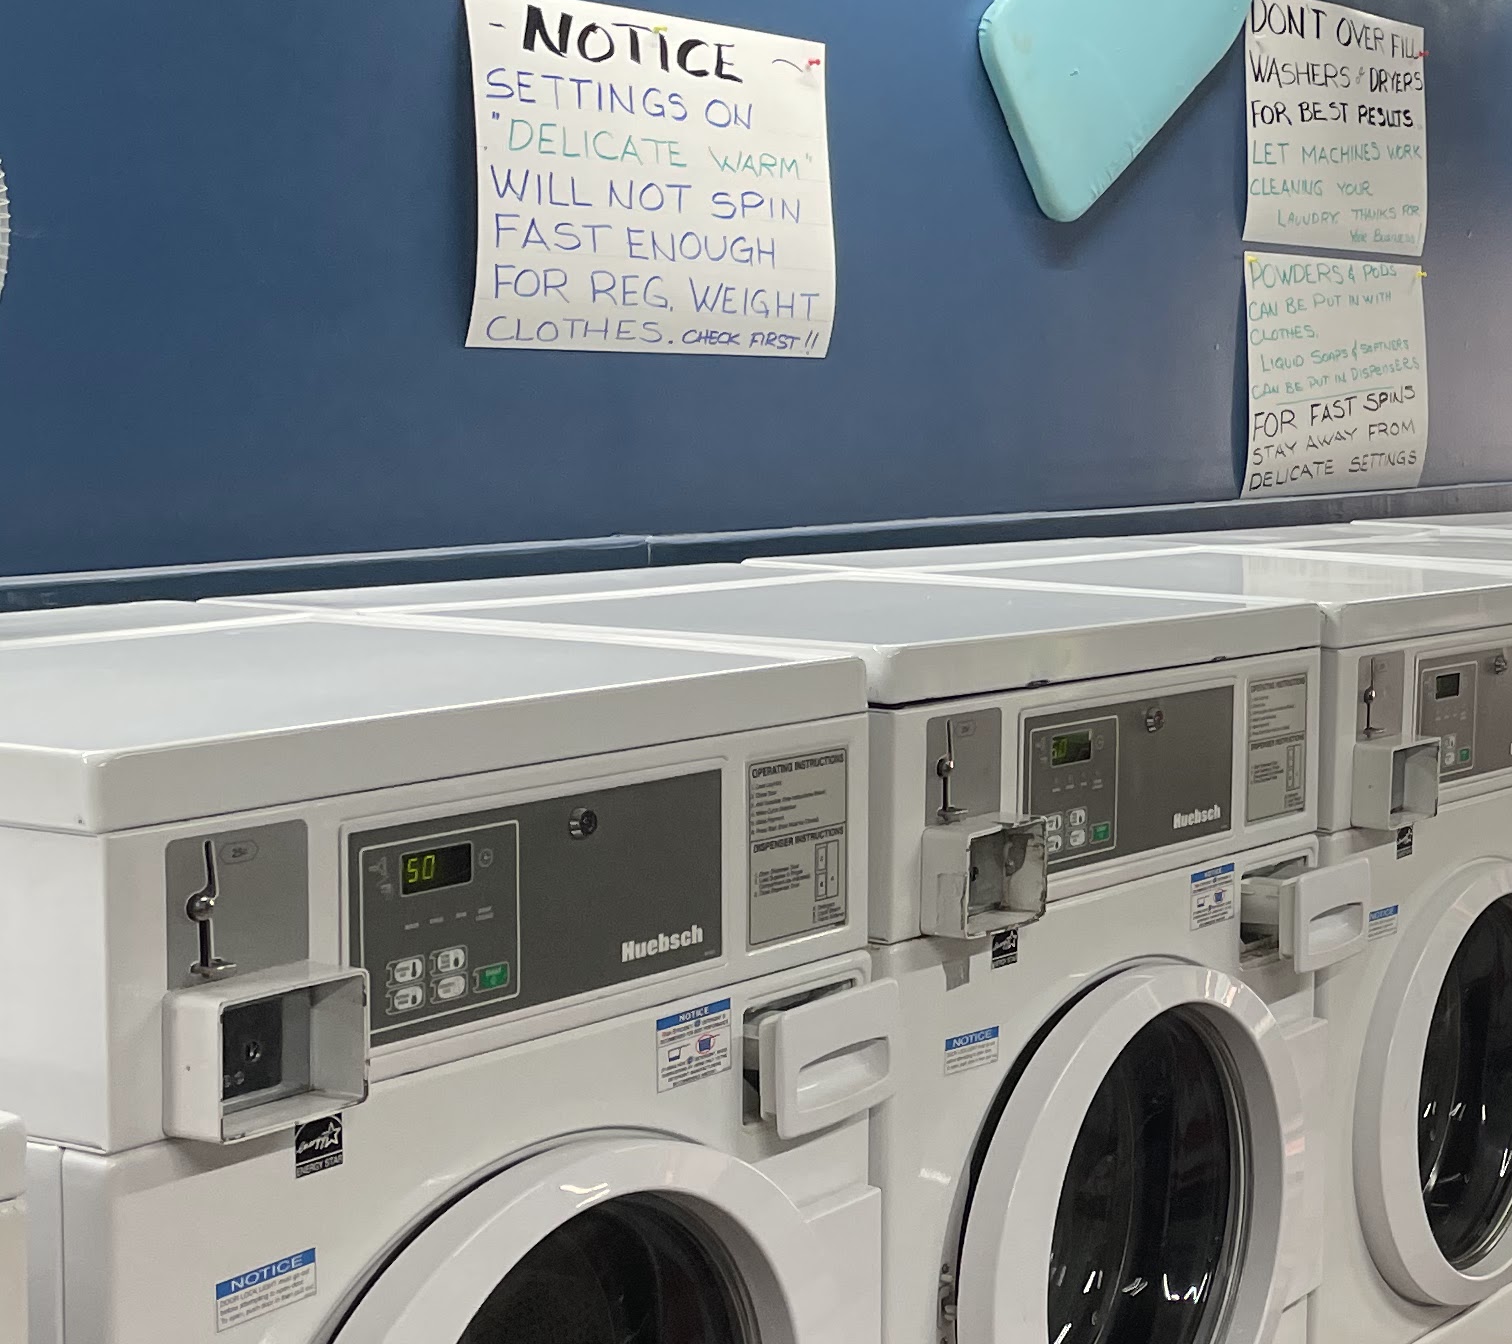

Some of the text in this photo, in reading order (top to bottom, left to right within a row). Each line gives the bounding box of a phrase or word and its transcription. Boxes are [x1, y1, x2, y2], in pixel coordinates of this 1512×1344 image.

[523, 5, 743, 83] NOTICE
[1337, 17, 1384, 56] OVER
[1391, 33, 1419, 59] FILL
[1249, 49, 1350, 88] WASHERS
[1369, 67, 1424, 93] DRYERS
[485, 68, 753, 129] SETTINGS ON
[1251, 100, 1292, 128] FOR
[1298, 101, 1348, 123] BEST
[1252, 140, 1422, 165] LET MACHINES WORK
[490, 165, 801, 224] WILL NOT SPIN
[1250, 177, 1373, 197] CLEANING YOUR
[1351, 204, 1421, 222] THANKS FOR
[495, 214, 776, 269] FAST ENOUGH
[494, 264, 819, 320] FOR REG. WEIGHT
[1250, 262, 1344, 289] POWDERS
[1362, 263, 1397, 280] PODS
[1249, 290, 1392, 321] CAN BE PUT IN WITH
[485, 316, 674, 346] CLOTHES.
[682, 328, 741, 347] CHECK
[1260, 353, 1304, 372] LIQUID
[1311, 348, 1349, 365] SOAPS
[1252, 383, 1279, 400] CAN
[1286, 381, 1303, 393] BE
[1308, 374, 1329, 389] PUT
[1334, 372, 1347, 383] IN
[1253, 385, 1416, 441] FOR FAST SPINS
[1252, 419, 1415, 466] STAY AWAY FROM
[1249, 450, 1417, 492] DELICATE SETTINGS
[406, 854, 436, 884] 50
[621, 924, 703, 963] Huebsch
[678, 1006, 710, 1022] NOTICE
[952, 1029, 993, 1047] NOTICE
[231, 1255, 303, 1292] NOTICE
